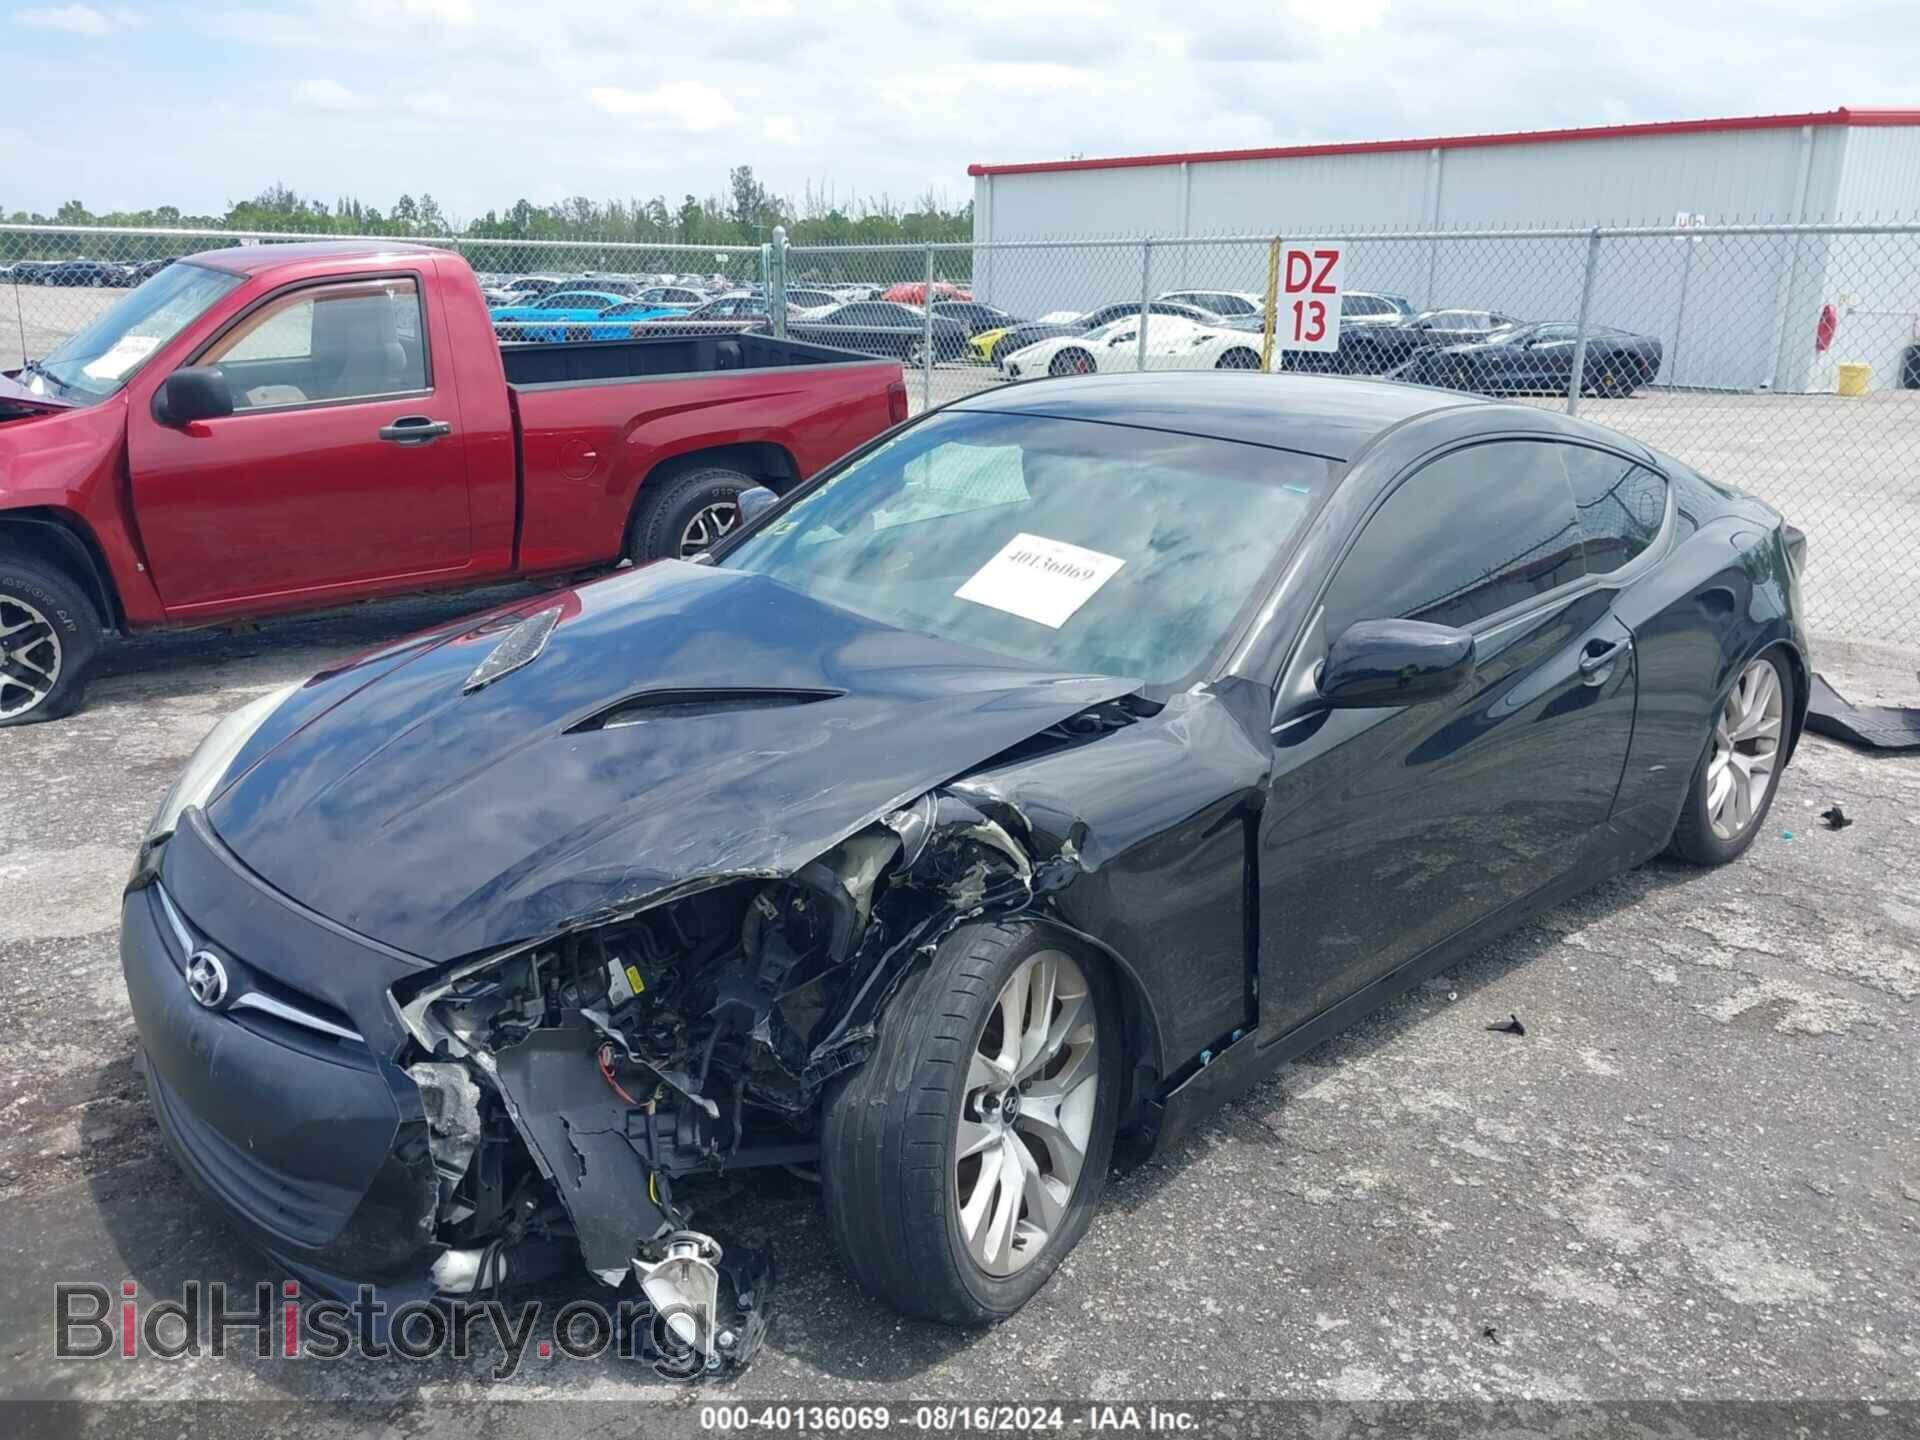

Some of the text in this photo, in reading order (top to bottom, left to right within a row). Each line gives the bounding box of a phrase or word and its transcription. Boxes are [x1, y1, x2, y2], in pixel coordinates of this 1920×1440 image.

[1284, 249, 1340, 294] DZ
[1292, 299, 1327, 343] 13
[1008, 549, 1096, 581] 40136069
